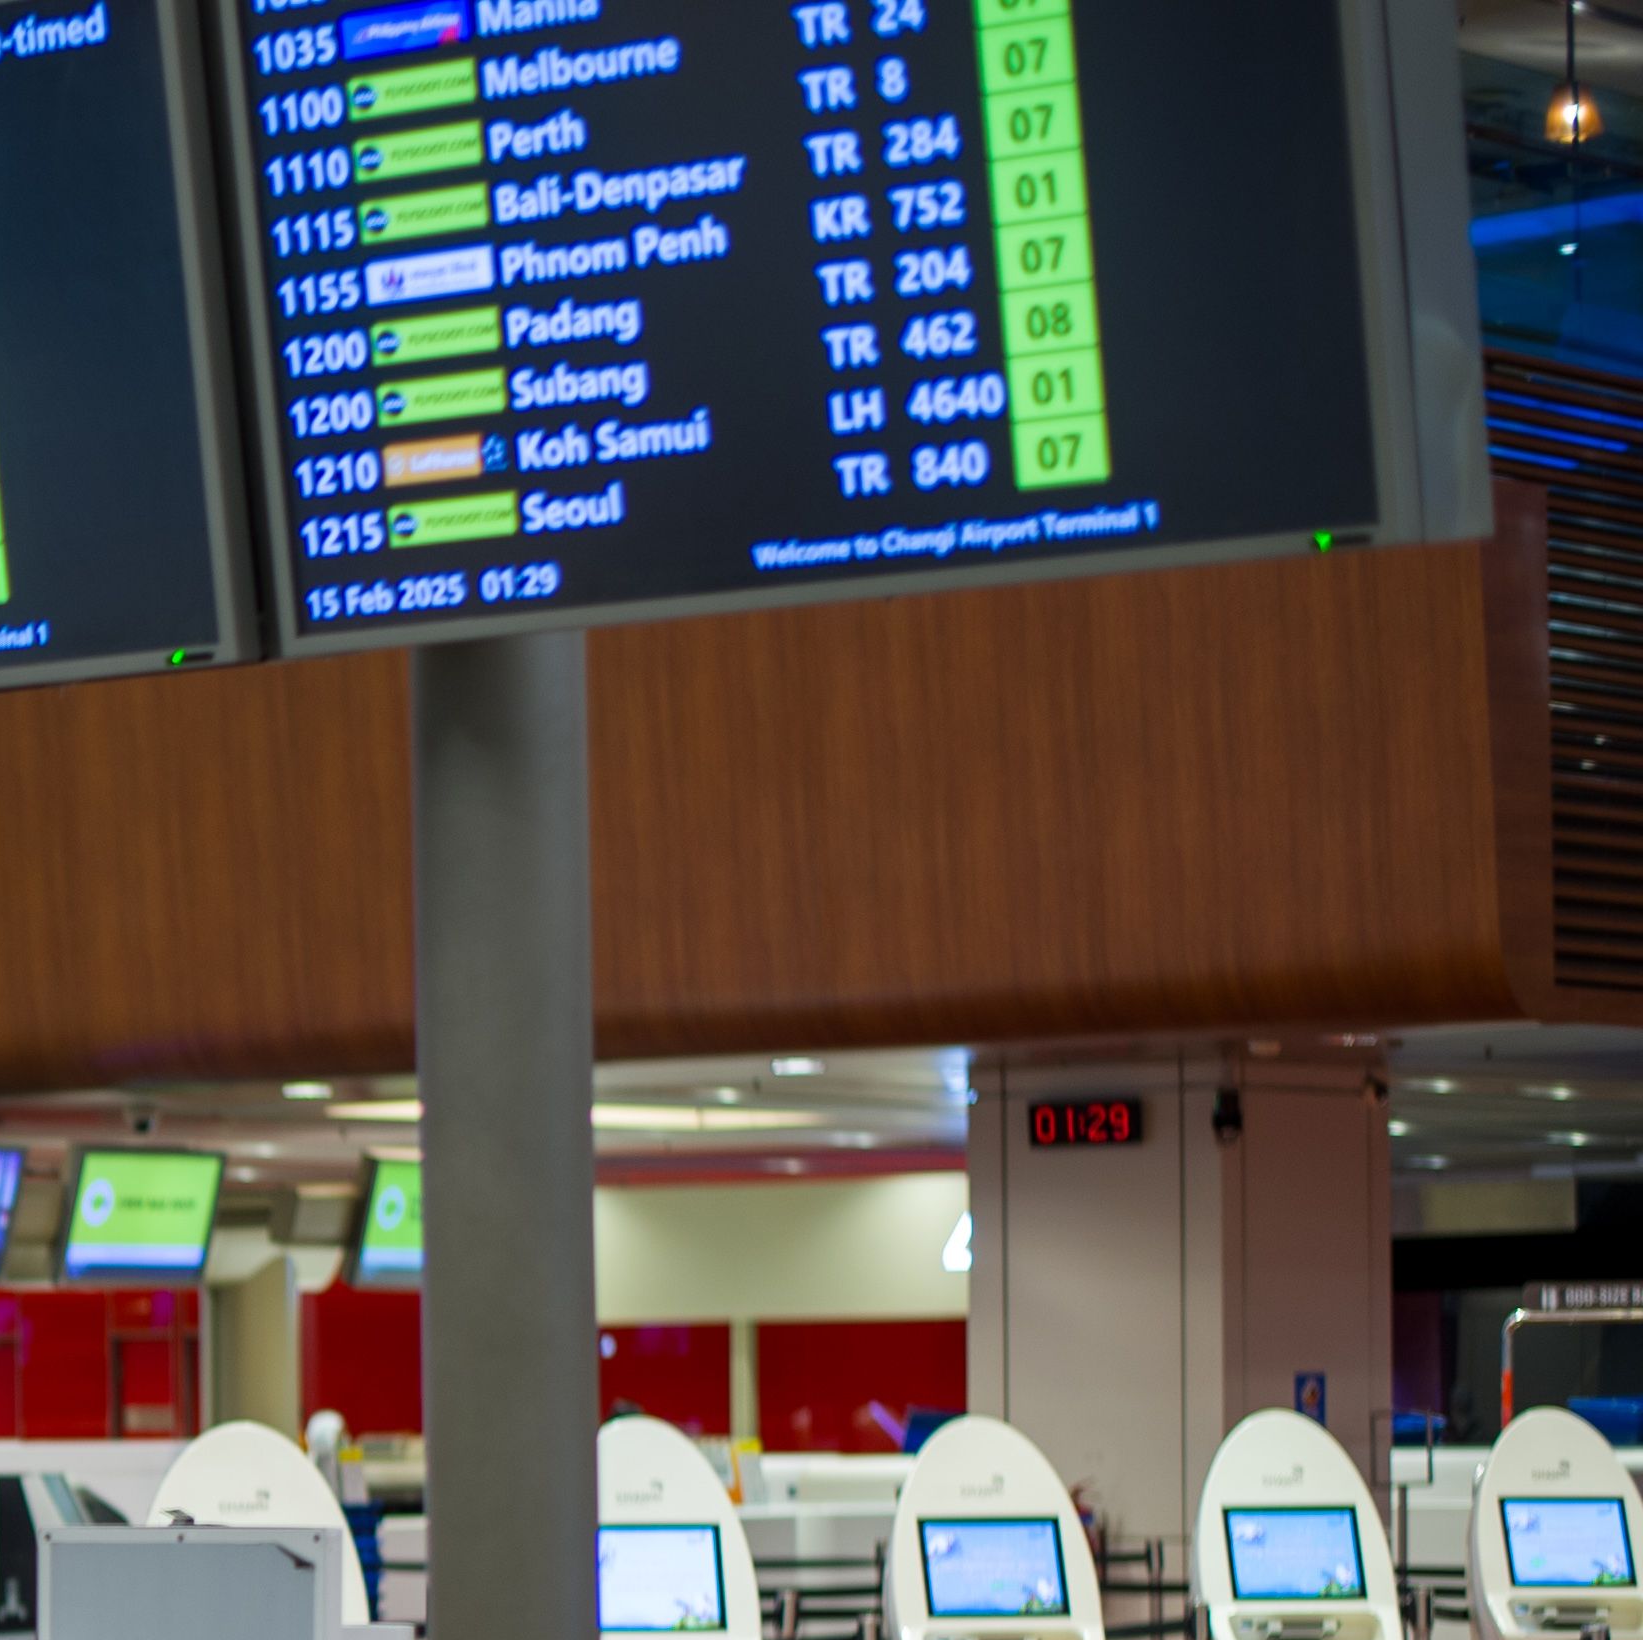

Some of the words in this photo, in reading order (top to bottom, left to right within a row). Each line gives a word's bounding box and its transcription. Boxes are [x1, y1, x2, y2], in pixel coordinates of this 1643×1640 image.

[262, 87, 343, 133] 1100
[483, 39, 678, 97] Melbourne
[268, 148, 349, 194] 1110
[489, 110, 585, 160] Perth
[274, 209, 354, 255] 1115
[495, 157, 743, 222] Bali-Denpasar
[279, 270, 360, 315] 1155
[500, 239, 627, 284] Phnom
[634, 216, 727, 265] Penh
[285, 330, 367, 375] 1200
[506, 300, 640, 346] Padang
[291, 391, 373, 435] 1200
[511, 364, 647, 408] Subang
[296, 452, 379, 496] 1210
[517, 425, 589, 469] Koh
[596, 410, 708, 460] Samui
[302, 512, 383, 555] 1215
[523, 483, 622, 531] Seoul
[1035, 1103, 1129, 1144] 01:29
